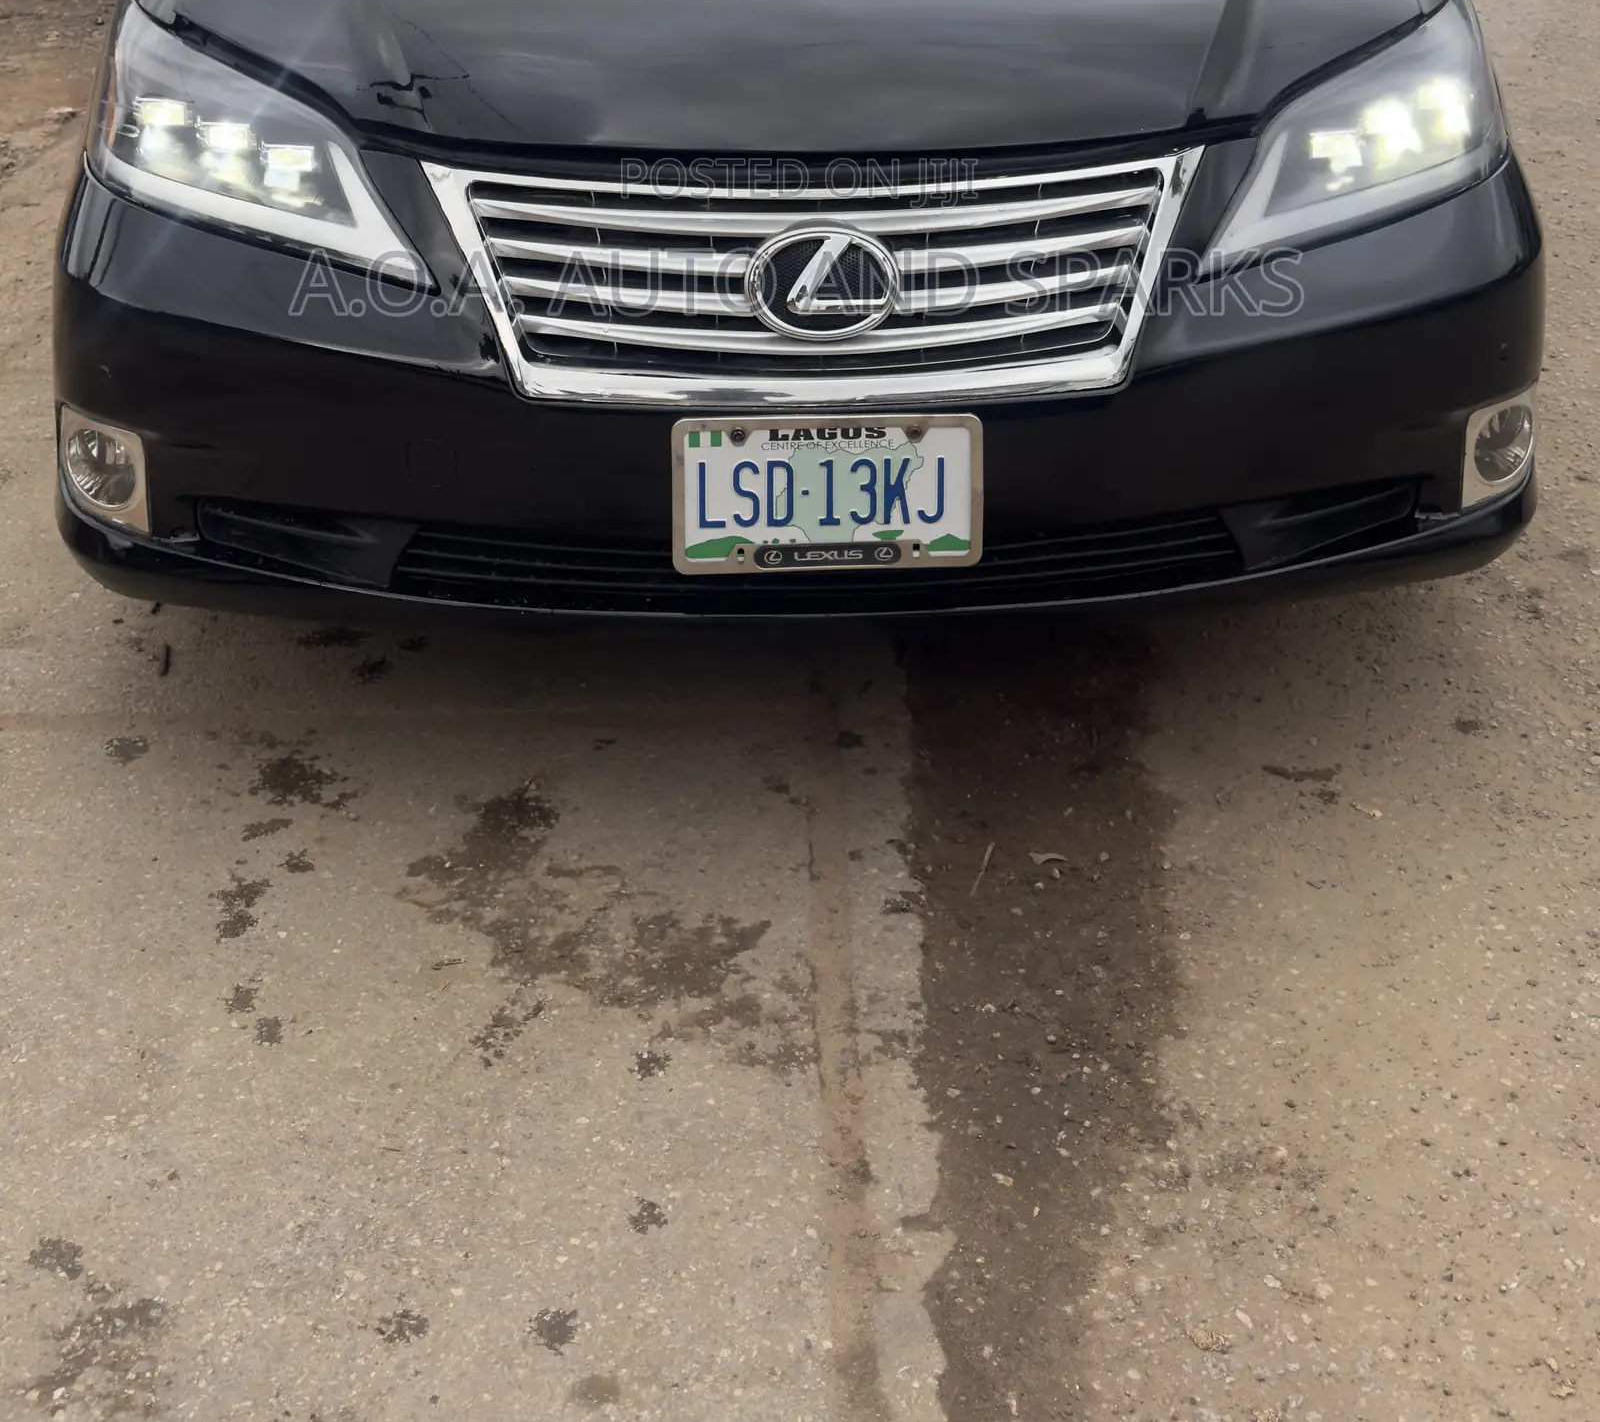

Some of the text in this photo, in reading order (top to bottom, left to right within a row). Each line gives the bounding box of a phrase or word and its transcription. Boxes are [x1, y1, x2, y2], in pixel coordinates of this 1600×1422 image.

[768, 427, 887, 441] LAGOS
[761, 439, 894, 451] CENTRE OF EXCELLENCE
[794, 550, 864, 561] LEXUS
